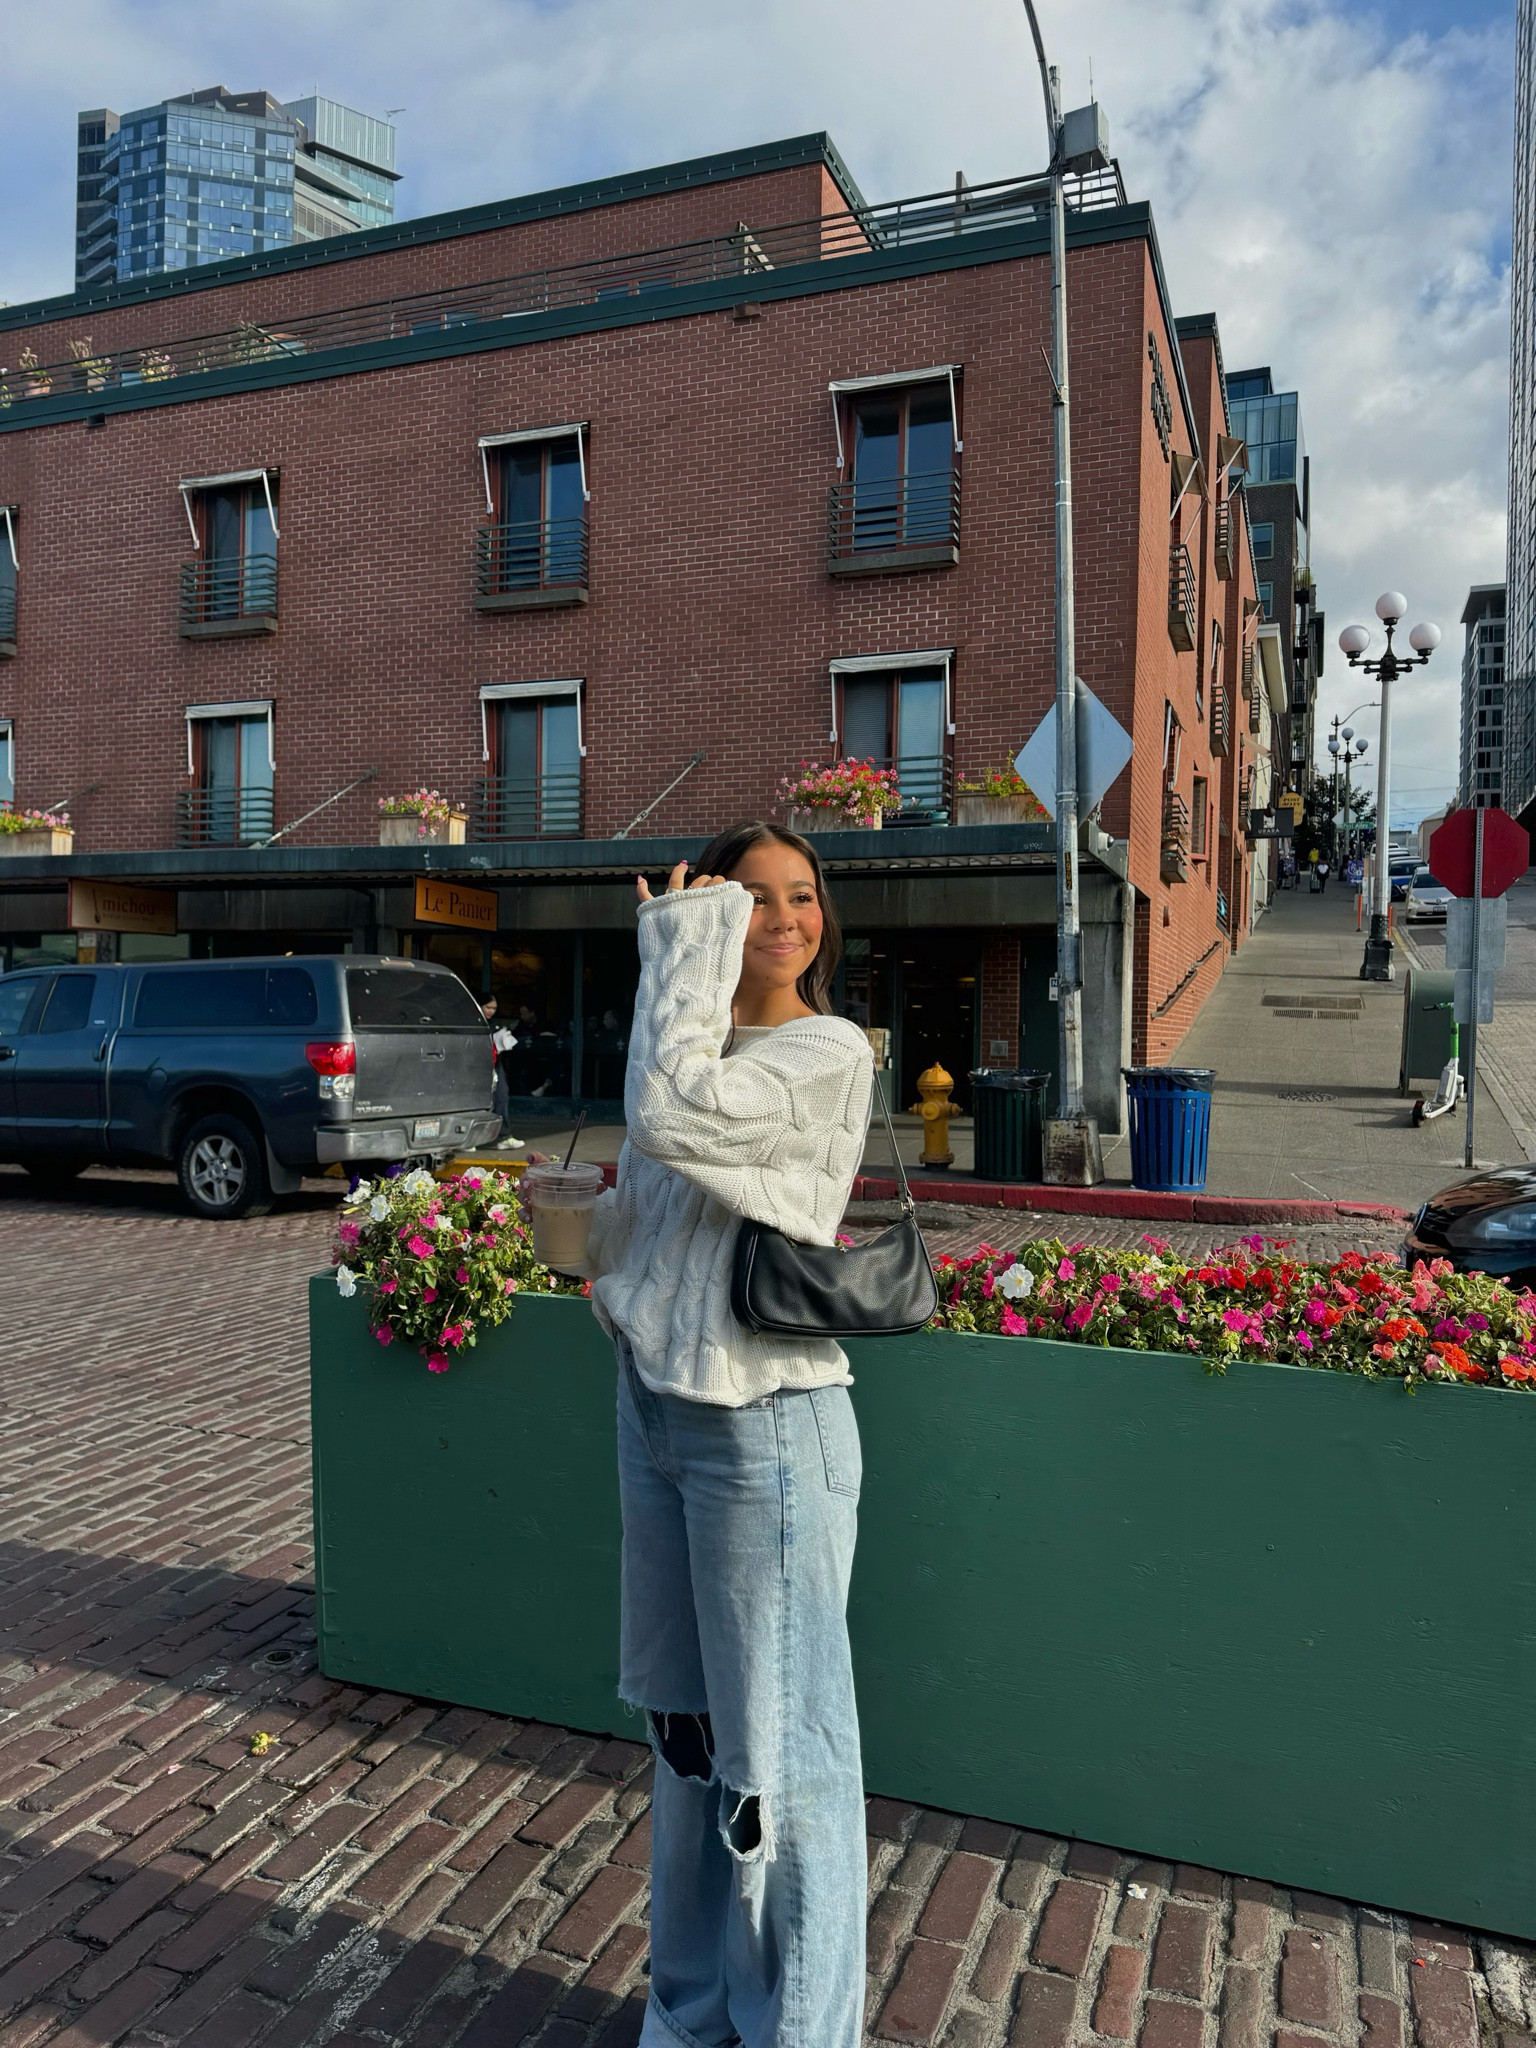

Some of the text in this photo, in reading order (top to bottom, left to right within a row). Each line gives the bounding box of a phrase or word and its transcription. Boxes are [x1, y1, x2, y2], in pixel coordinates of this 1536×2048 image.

[102, 896, 156, 916] michou
[424, 887, 494, 921] Le Panier
[355, 1104, 393, 1114] TUNDRA
